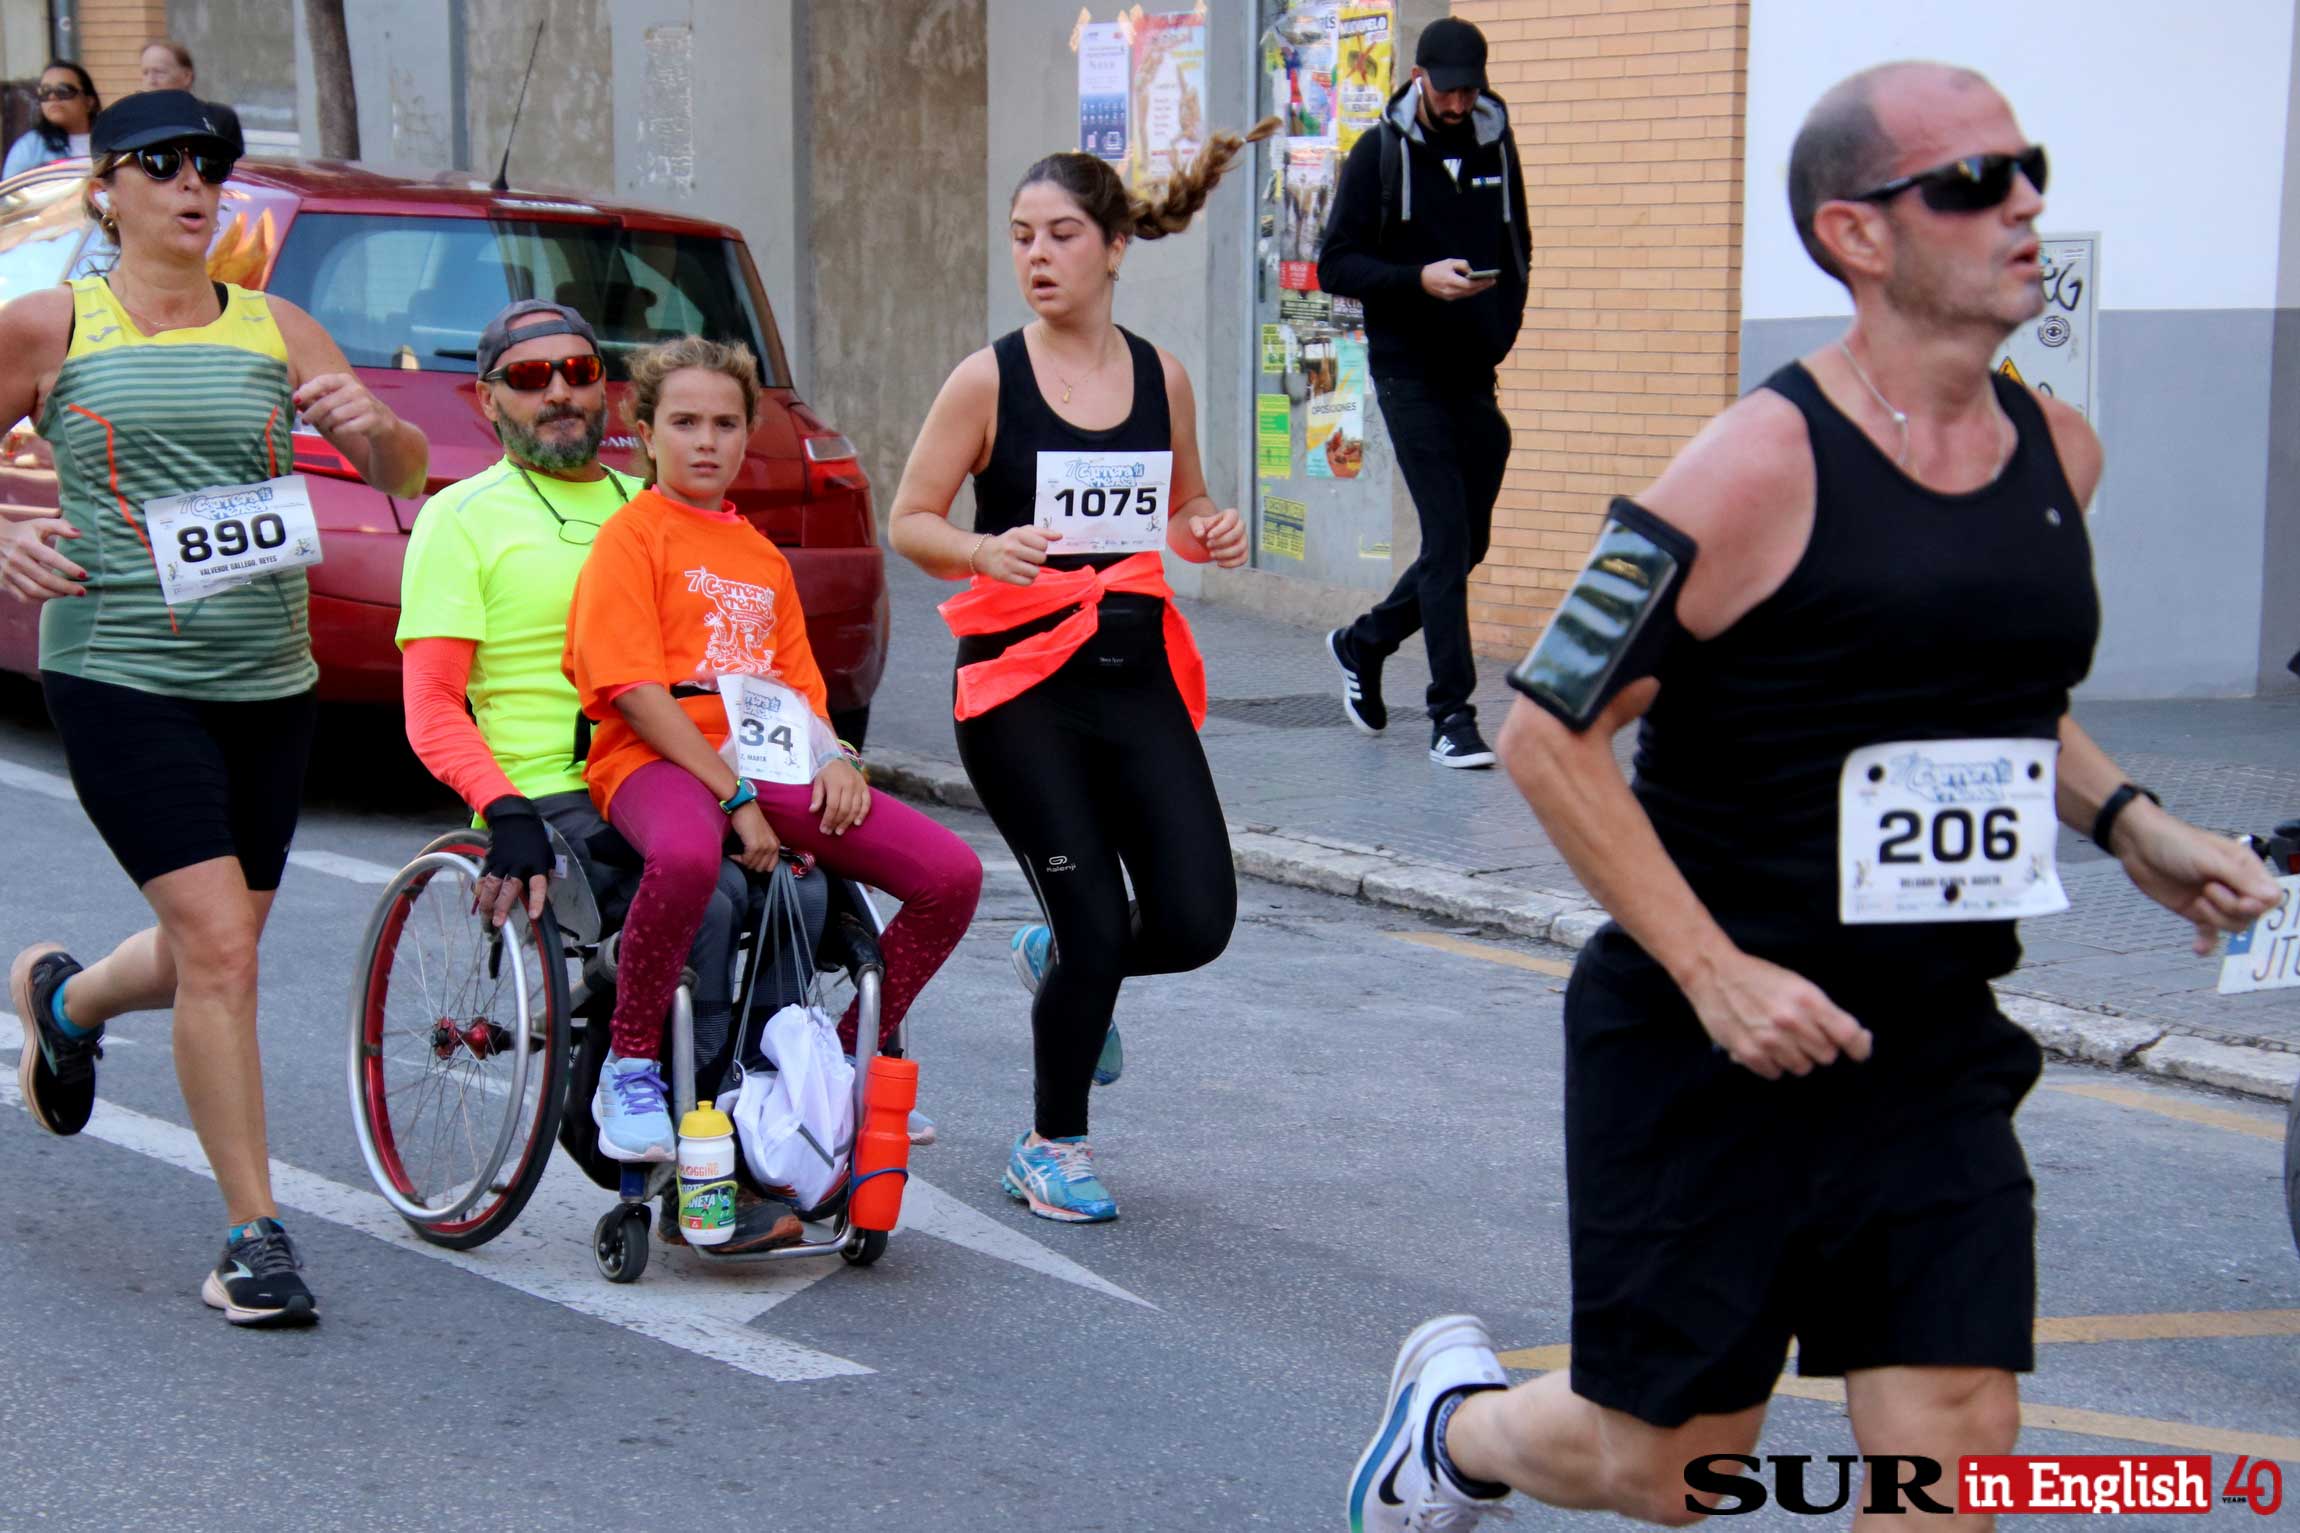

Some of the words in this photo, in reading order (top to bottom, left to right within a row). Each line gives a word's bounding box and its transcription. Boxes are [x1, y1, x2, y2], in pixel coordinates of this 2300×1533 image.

[1054, 487, 1157, 517] 1075
[177, 513, 286, 563] 890
[739, 718, 793, 752] 34
[1878, 807, 2019, 864] 206
